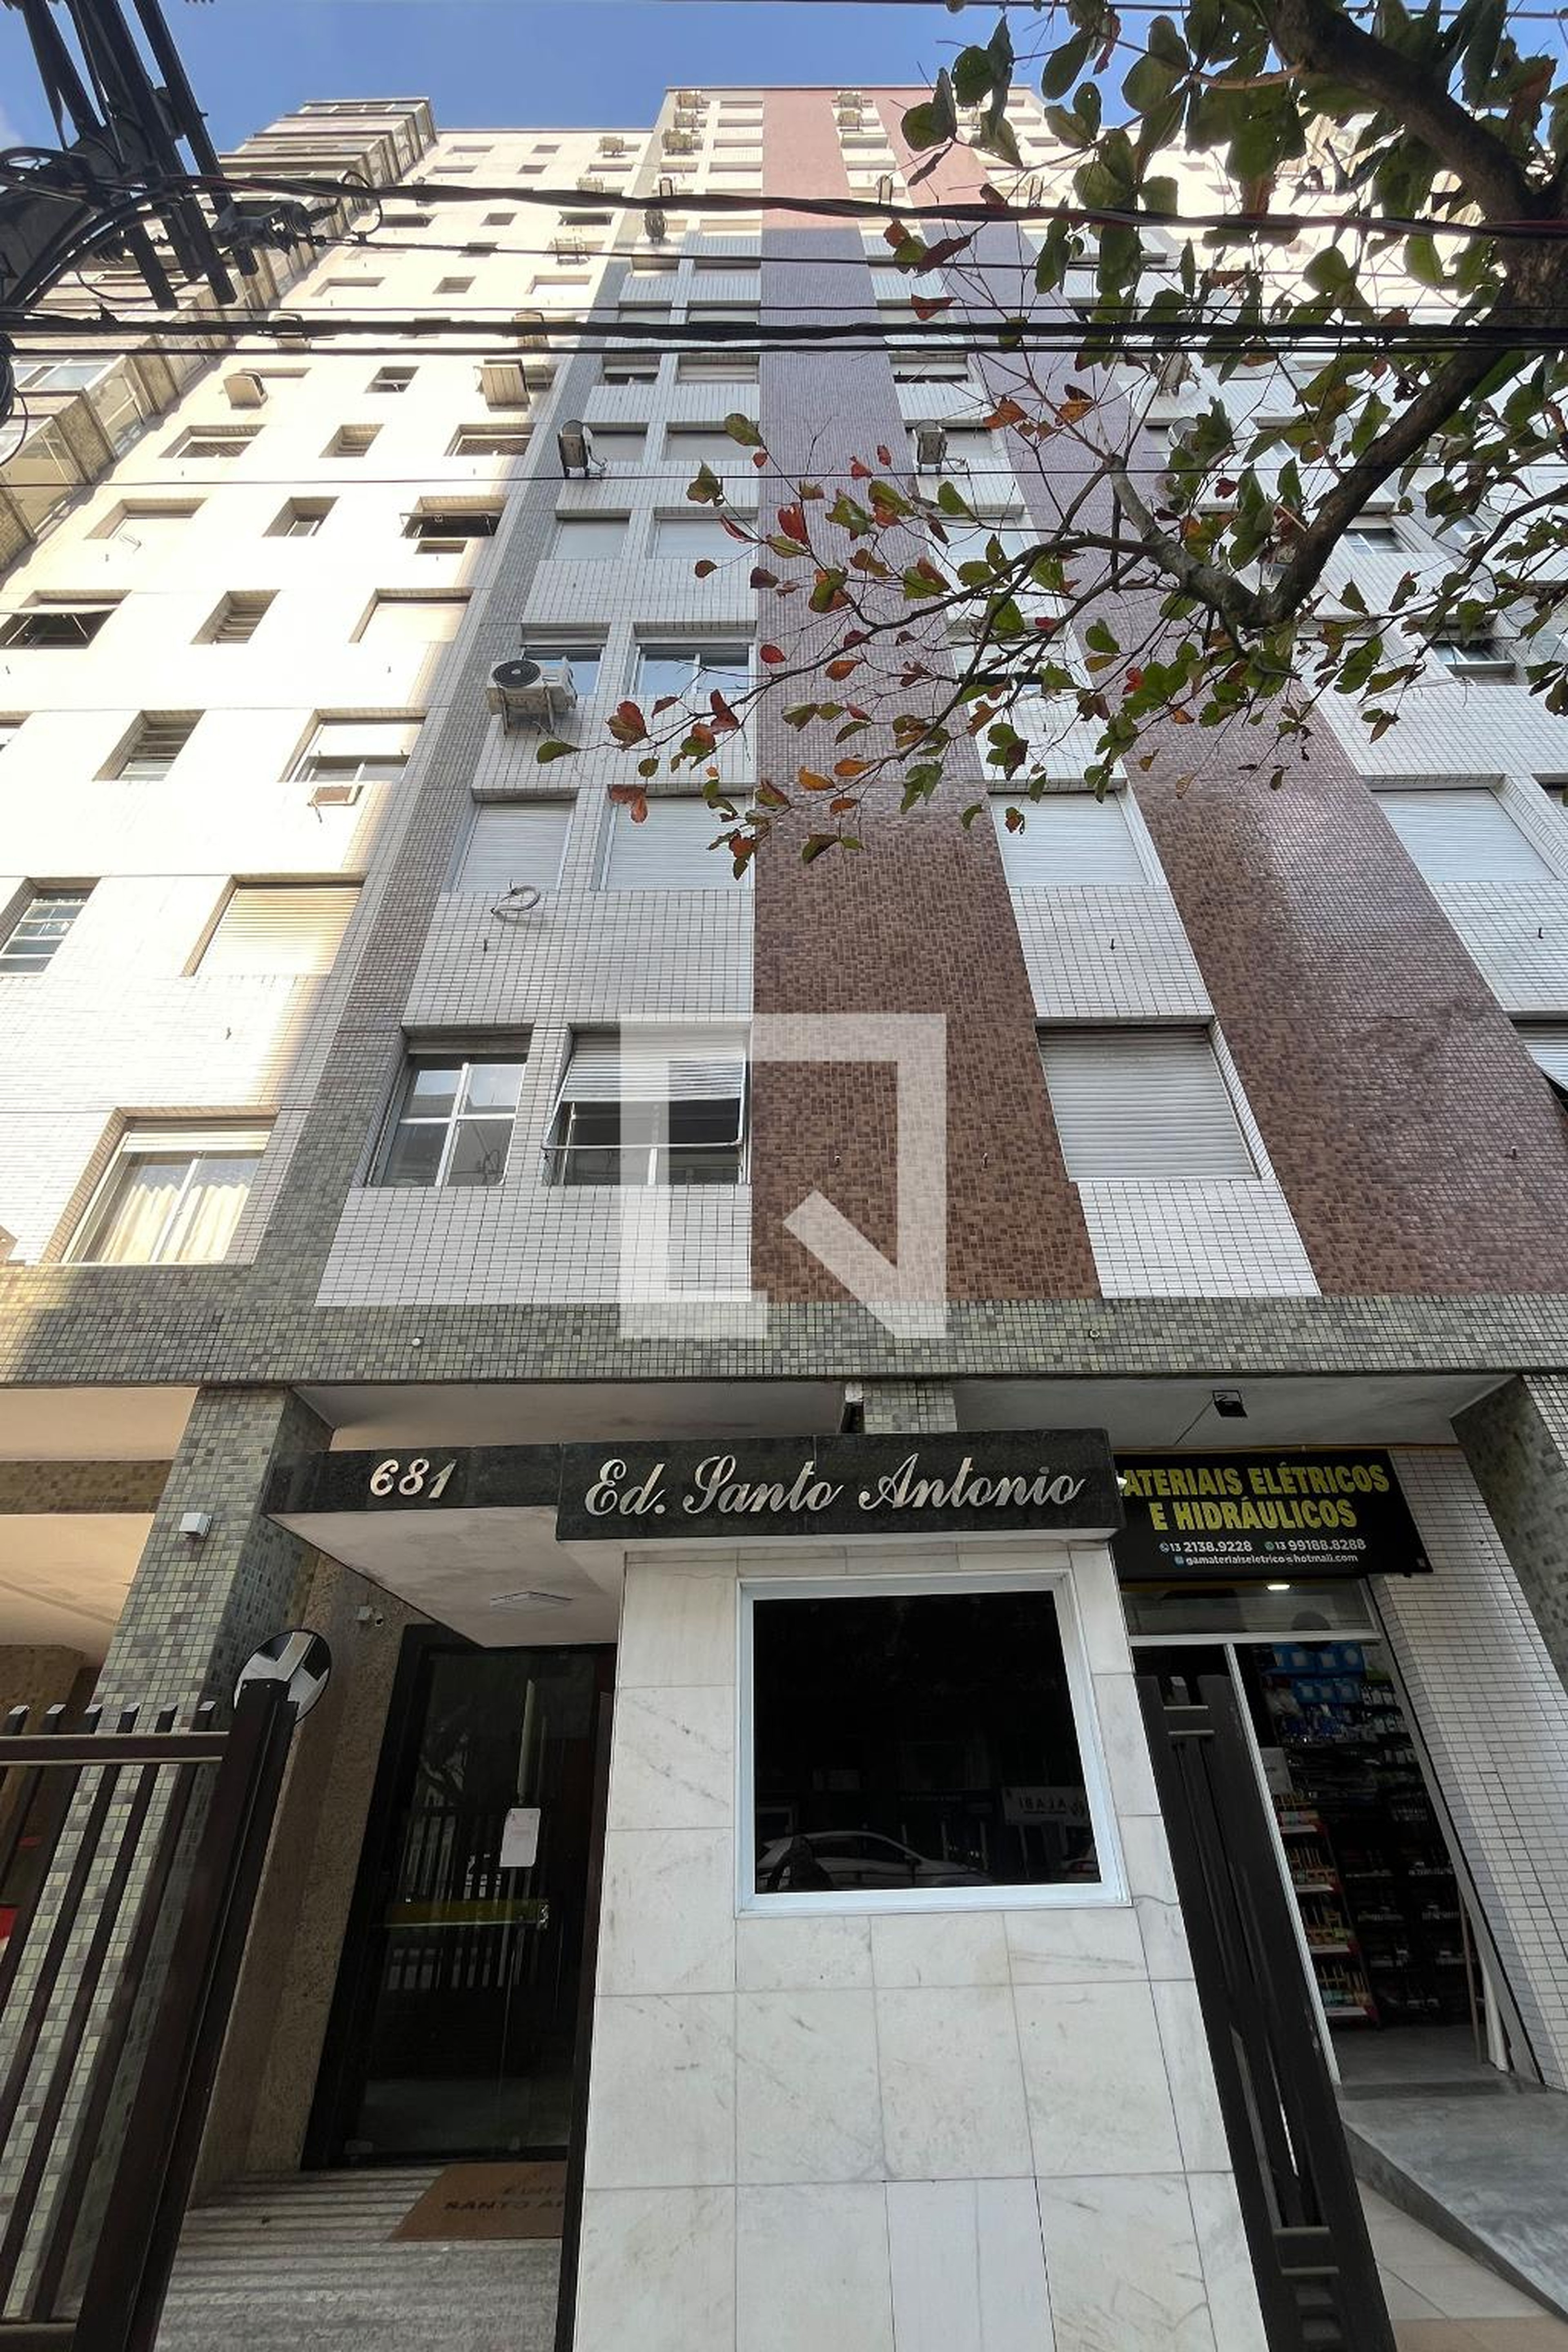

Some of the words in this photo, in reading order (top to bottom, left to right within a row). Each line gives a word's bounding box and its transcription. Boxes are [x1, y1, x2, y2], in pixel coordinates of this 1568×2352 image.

[370, 1458, 457, 1499] 681
[584, 1458, 666, 1516] Ed.
[681, 1454, 844, 1514] Santo
[857, 1452, 1085, 1511] Antonio
[1247, 1462, 1389, 1495] ELÉTRICOS
[1149, 1502, 1169, 1531] E
[1174, 1497, 1357, 1530] HIDRÁULICOS
[1169, 1543, 1181, 1552] 13
[1183, 1541, 1252, 1553] 2138.9228
[1275, 1541, 1286, 1551] 13
